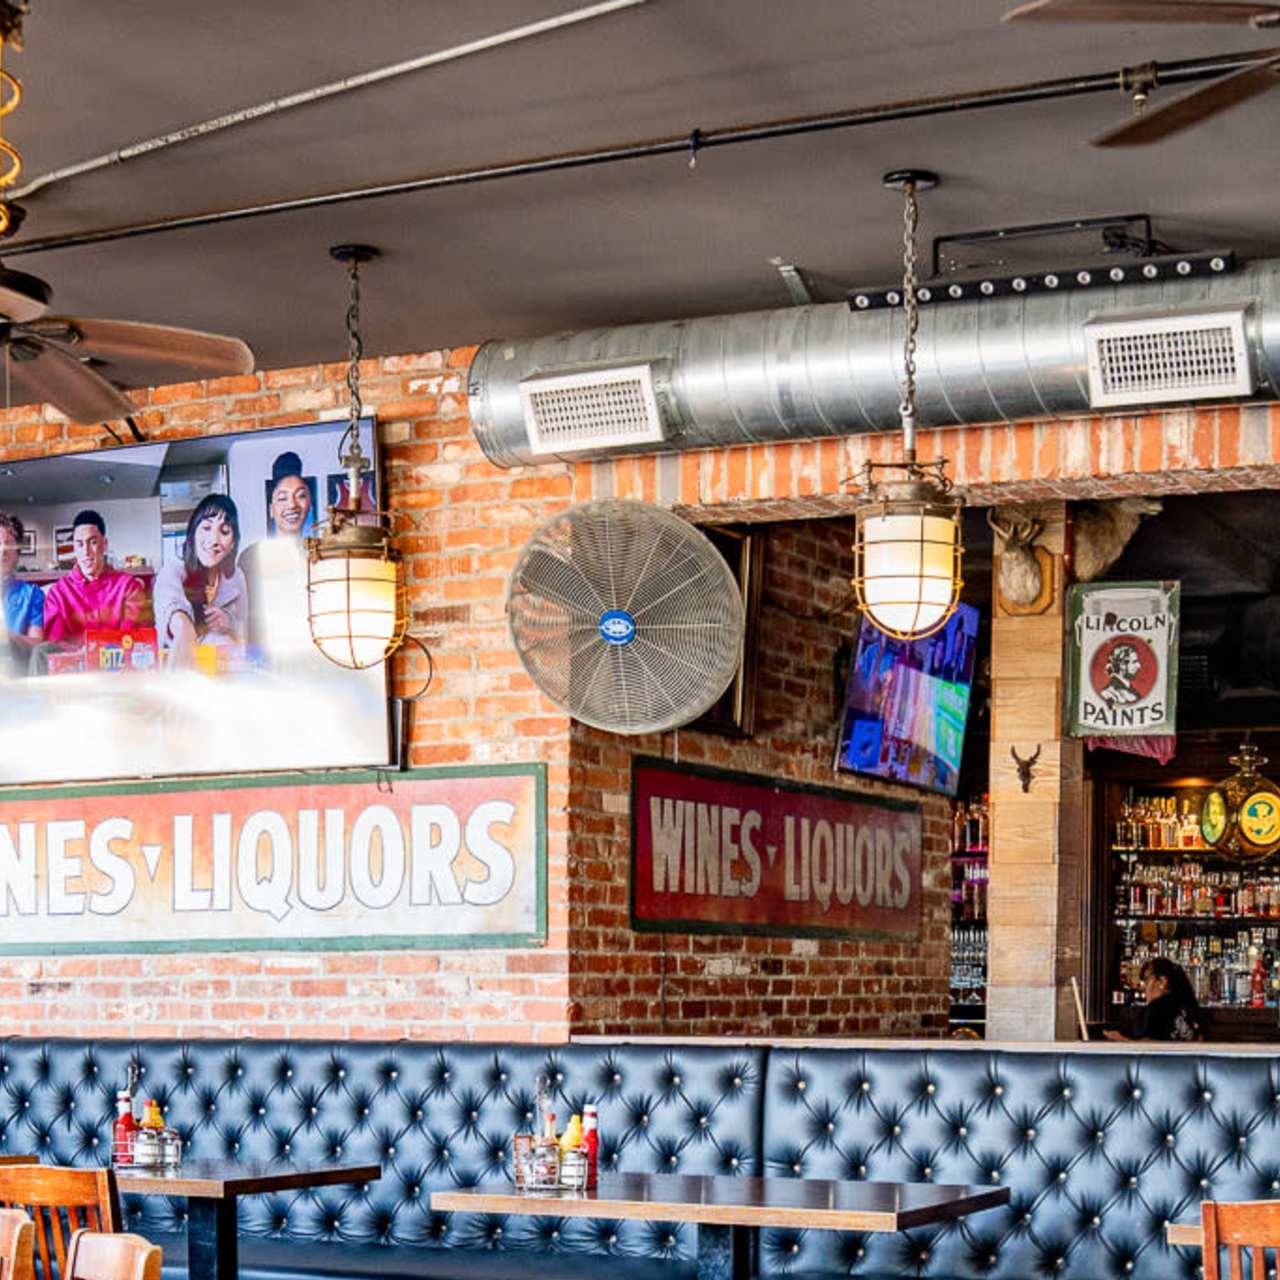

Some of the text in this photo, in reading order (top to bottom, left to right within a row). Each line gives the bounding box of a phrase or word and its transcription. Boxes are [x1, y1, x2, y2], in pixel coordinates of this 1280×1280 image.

[1083, 702, 1164, 726] PAINTS
[173, 800, 518, 922] LIQUORS
[650, 796, 911, 913] WINES LIQUORS
